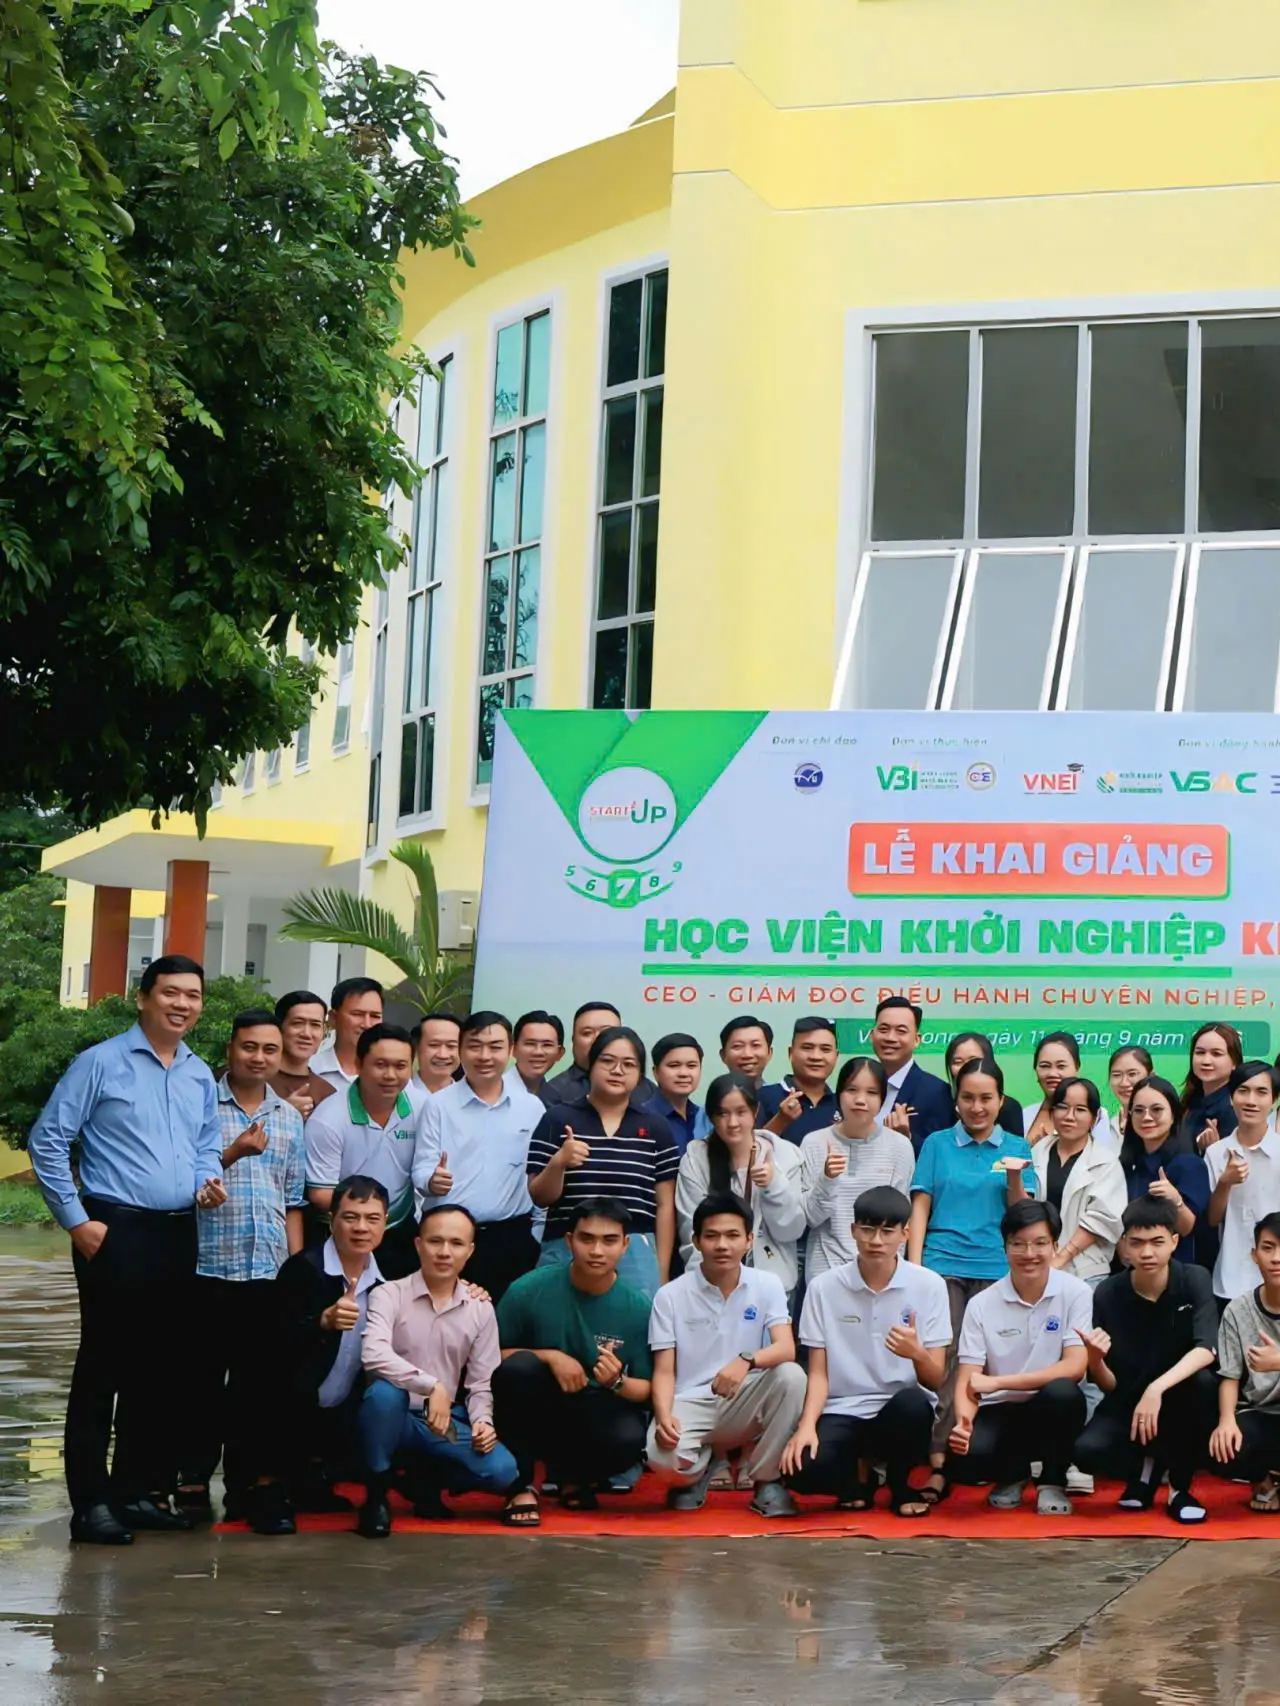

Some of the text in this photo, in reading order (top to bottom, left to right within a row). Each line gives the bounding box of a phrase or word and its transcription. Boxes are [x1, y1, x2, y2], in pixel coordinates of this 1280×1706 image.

[863, 828, 1214, 876] LỄ KHAI GIẢNG
[565, 861, 683, 900] 5 6 7 8 9
[643, 918, 749, 960] HỌC
[766, 909, 883, 961] VIỆN
[900, 909, 1021, 954] KHỞI
[1038, 912, 1226, 962] NGHIỆP
[644, 986, 698, 1003] CEO
[1043, 984, 1152, 1005] CHUYÊN
[1118, 1030, 1132, 1045] 9
